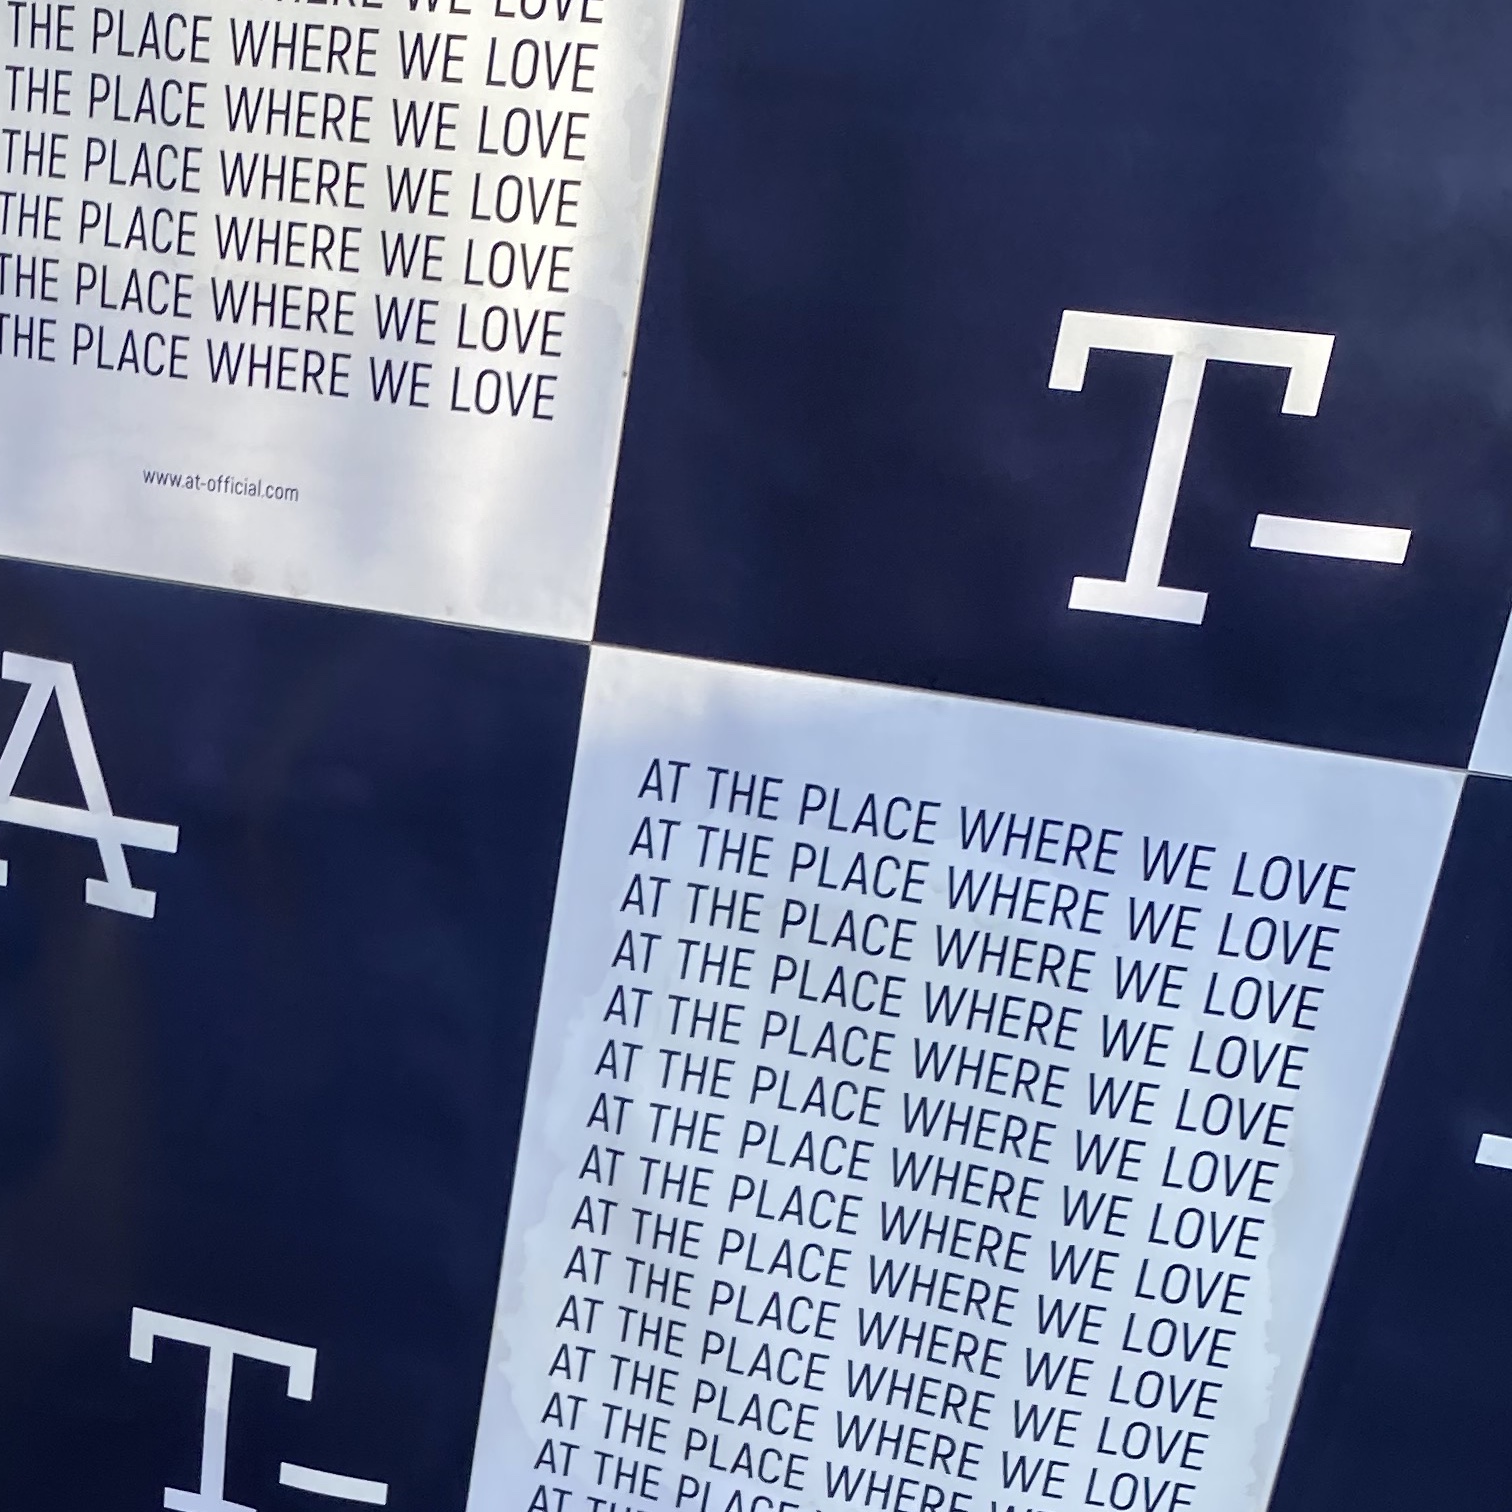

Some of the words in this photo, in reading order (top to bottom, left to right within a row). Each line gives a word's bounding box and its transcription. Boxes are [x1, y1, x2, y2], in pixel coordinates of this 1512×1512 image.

[4, 64, 73, 117] THE
[88, 71, 209, 130] PLACE
[223, 84, 374, 145] WHERE
[391, 98, 461, 152] WE
[478, 104, 591, 162] LOVE
[8, 1, 76, 53] THE
[91, 6, 213, 64] PLACE
[229, 17, 381, 78] WHERE
[397, 29, 468, 85] WE
[485, 35, 599, 94] LOVE
[78, 199, 198, 258] PLACE
[214, 213, 363, 274] WHERE
[380, 229, 447, 283] WE
[463, 238, 575, 294] LOVE
[71, 322, 191, 380] PLACE
[206, 337, 353, 399] WHERE
[368, 355, 433, 408] WE
[450, 365, 559, 421] LOVE
[142, 468, 299, 502] www.at-official.com
[628, 815, 682, 862] AT
[696, 824, 774, 879] THE
[788, 840, 931, 905] PLACE
[947, 864, 1110, 936] WHERE
[1128, 895, 1203, 952] WE
[1217, 912, 1341, 973] LOVE
[636, 757, 692, 804] AT
[706, 765, 785, 822] THE
[797, 782, 942, 845] PLACE
[959, 805, 1124, 875] WHERE
[1142, 835, 1217, 892] WE
[1231, 850, 1356, 912] LOVE
[611, 929, 663, 975] AT
[676, 937, 756, 991] THE
[770, 953, 907, 1019] PLACE
[924, 980, 1084, 1053] WHERE
[1101, 1013, 1175, 1069] WE
[1188, 1029, 1310, 1091] LOVE
[594, 1038, 645, 1083] AT
[658, 1047, 737, 1100] THE
[748, 1064, 886, 1128] PLACE
[902, 1091, 1058, 1166] WHERE
[1075, 1128, 1148, 1183] WE
[1160, 1145, 1280, 1204] LOVE
[577, 1143, 627, 1187] AT
[638, 1155, 715, 1209] THE
[727, 1173, 864, 1236] PLACE
[880, 1200, 1033, 1275] WHERE
[1050, 1239, 1120, 1293] WE
[1134, 1257, 1251, 1317] LOVE
[563, 1244, 612, 1286] AT
[625, 1255, 695, 1311] THE
[708, 1279, 841, 1341] PLACE
[857, 1306, 1009, 1380] WHERE
[1025, 1346, 1095, 1398] WE
[1108, 1364, 1224, 1421] LOVE
[532, 1437, 581, 1478] AT
[592, 1449, 664, 1502] THE
[548, 1342, 597, 1383] AT
[609, 1353, 680, 1408] THE
[691, 1377, 820, 1443] PLACE
[835, 1409, 985, 1482] WHERE
[1001, 1449, 1071, 1500] WE
